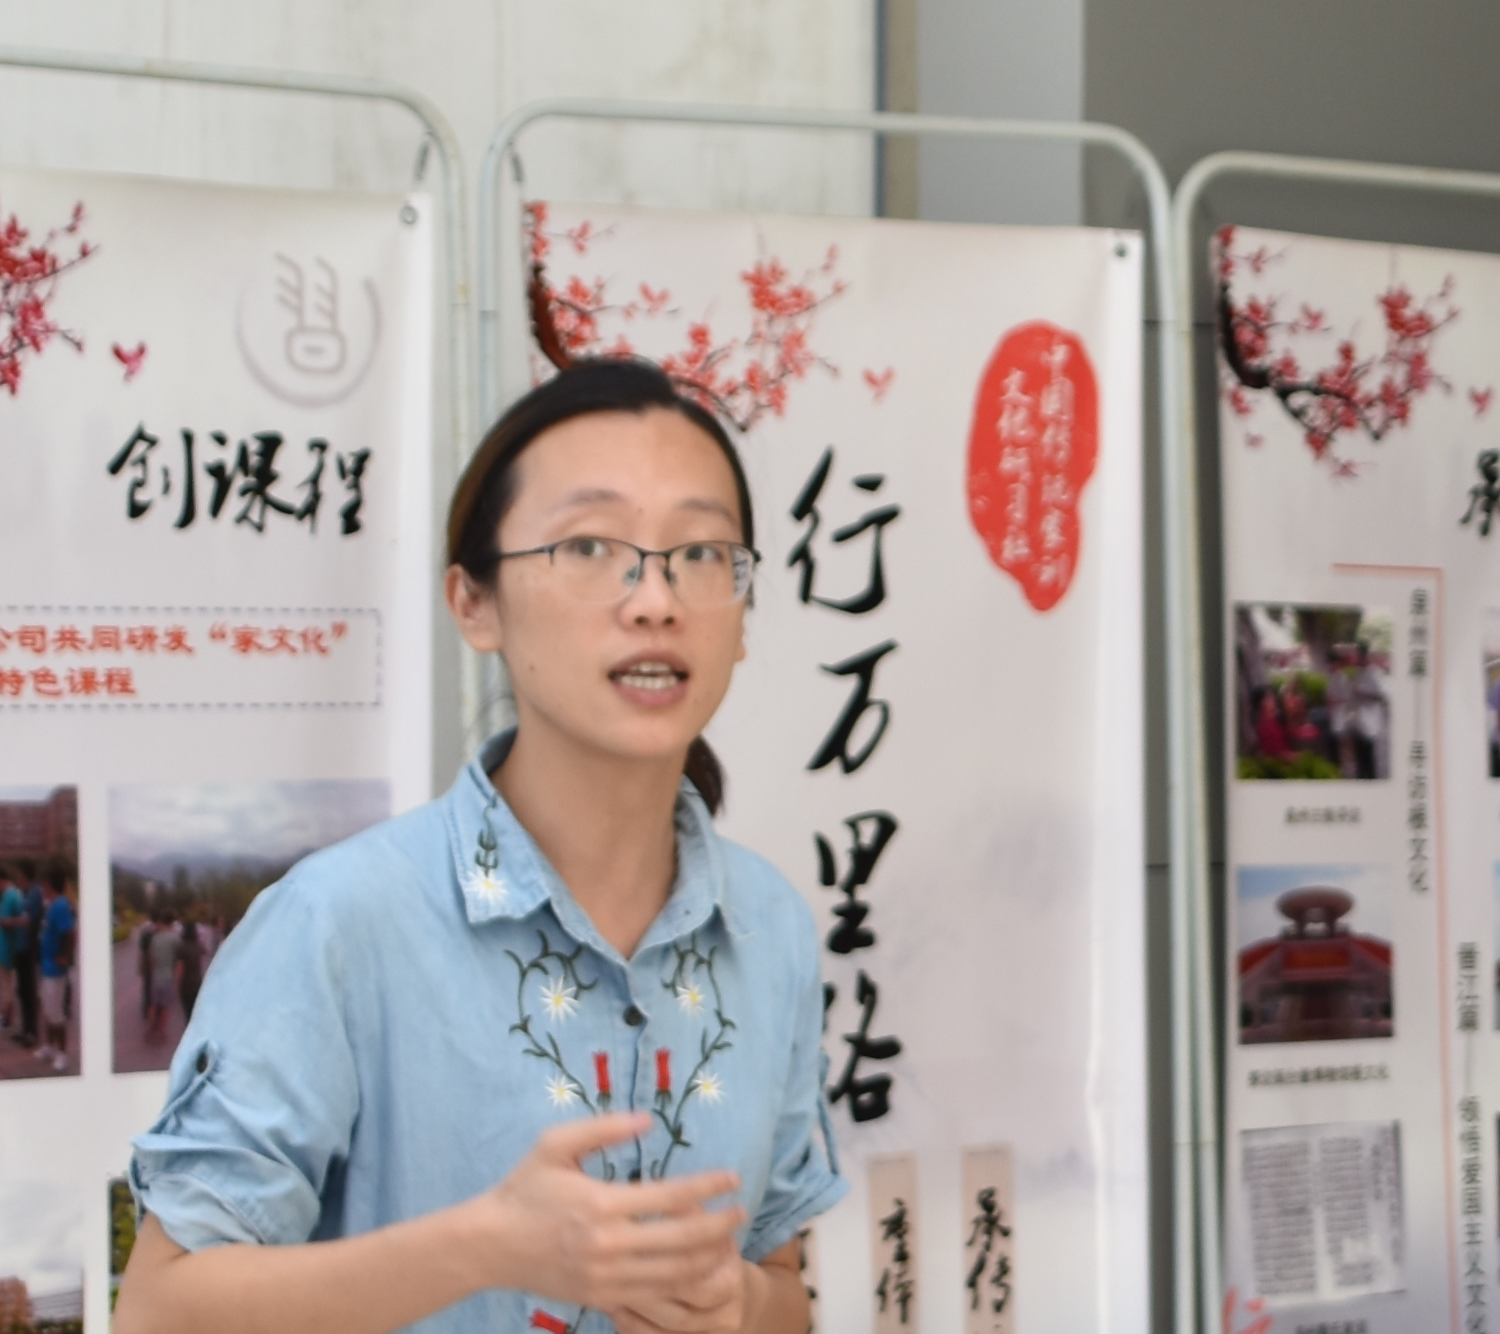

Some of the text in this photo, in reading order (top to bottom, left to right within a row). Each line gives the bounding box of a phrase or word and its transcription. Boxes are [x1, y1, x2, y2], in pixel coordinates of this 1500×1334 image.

[107, 424, 374, 537] 创课程
[787, 444, 903, 1125] 行万里路
